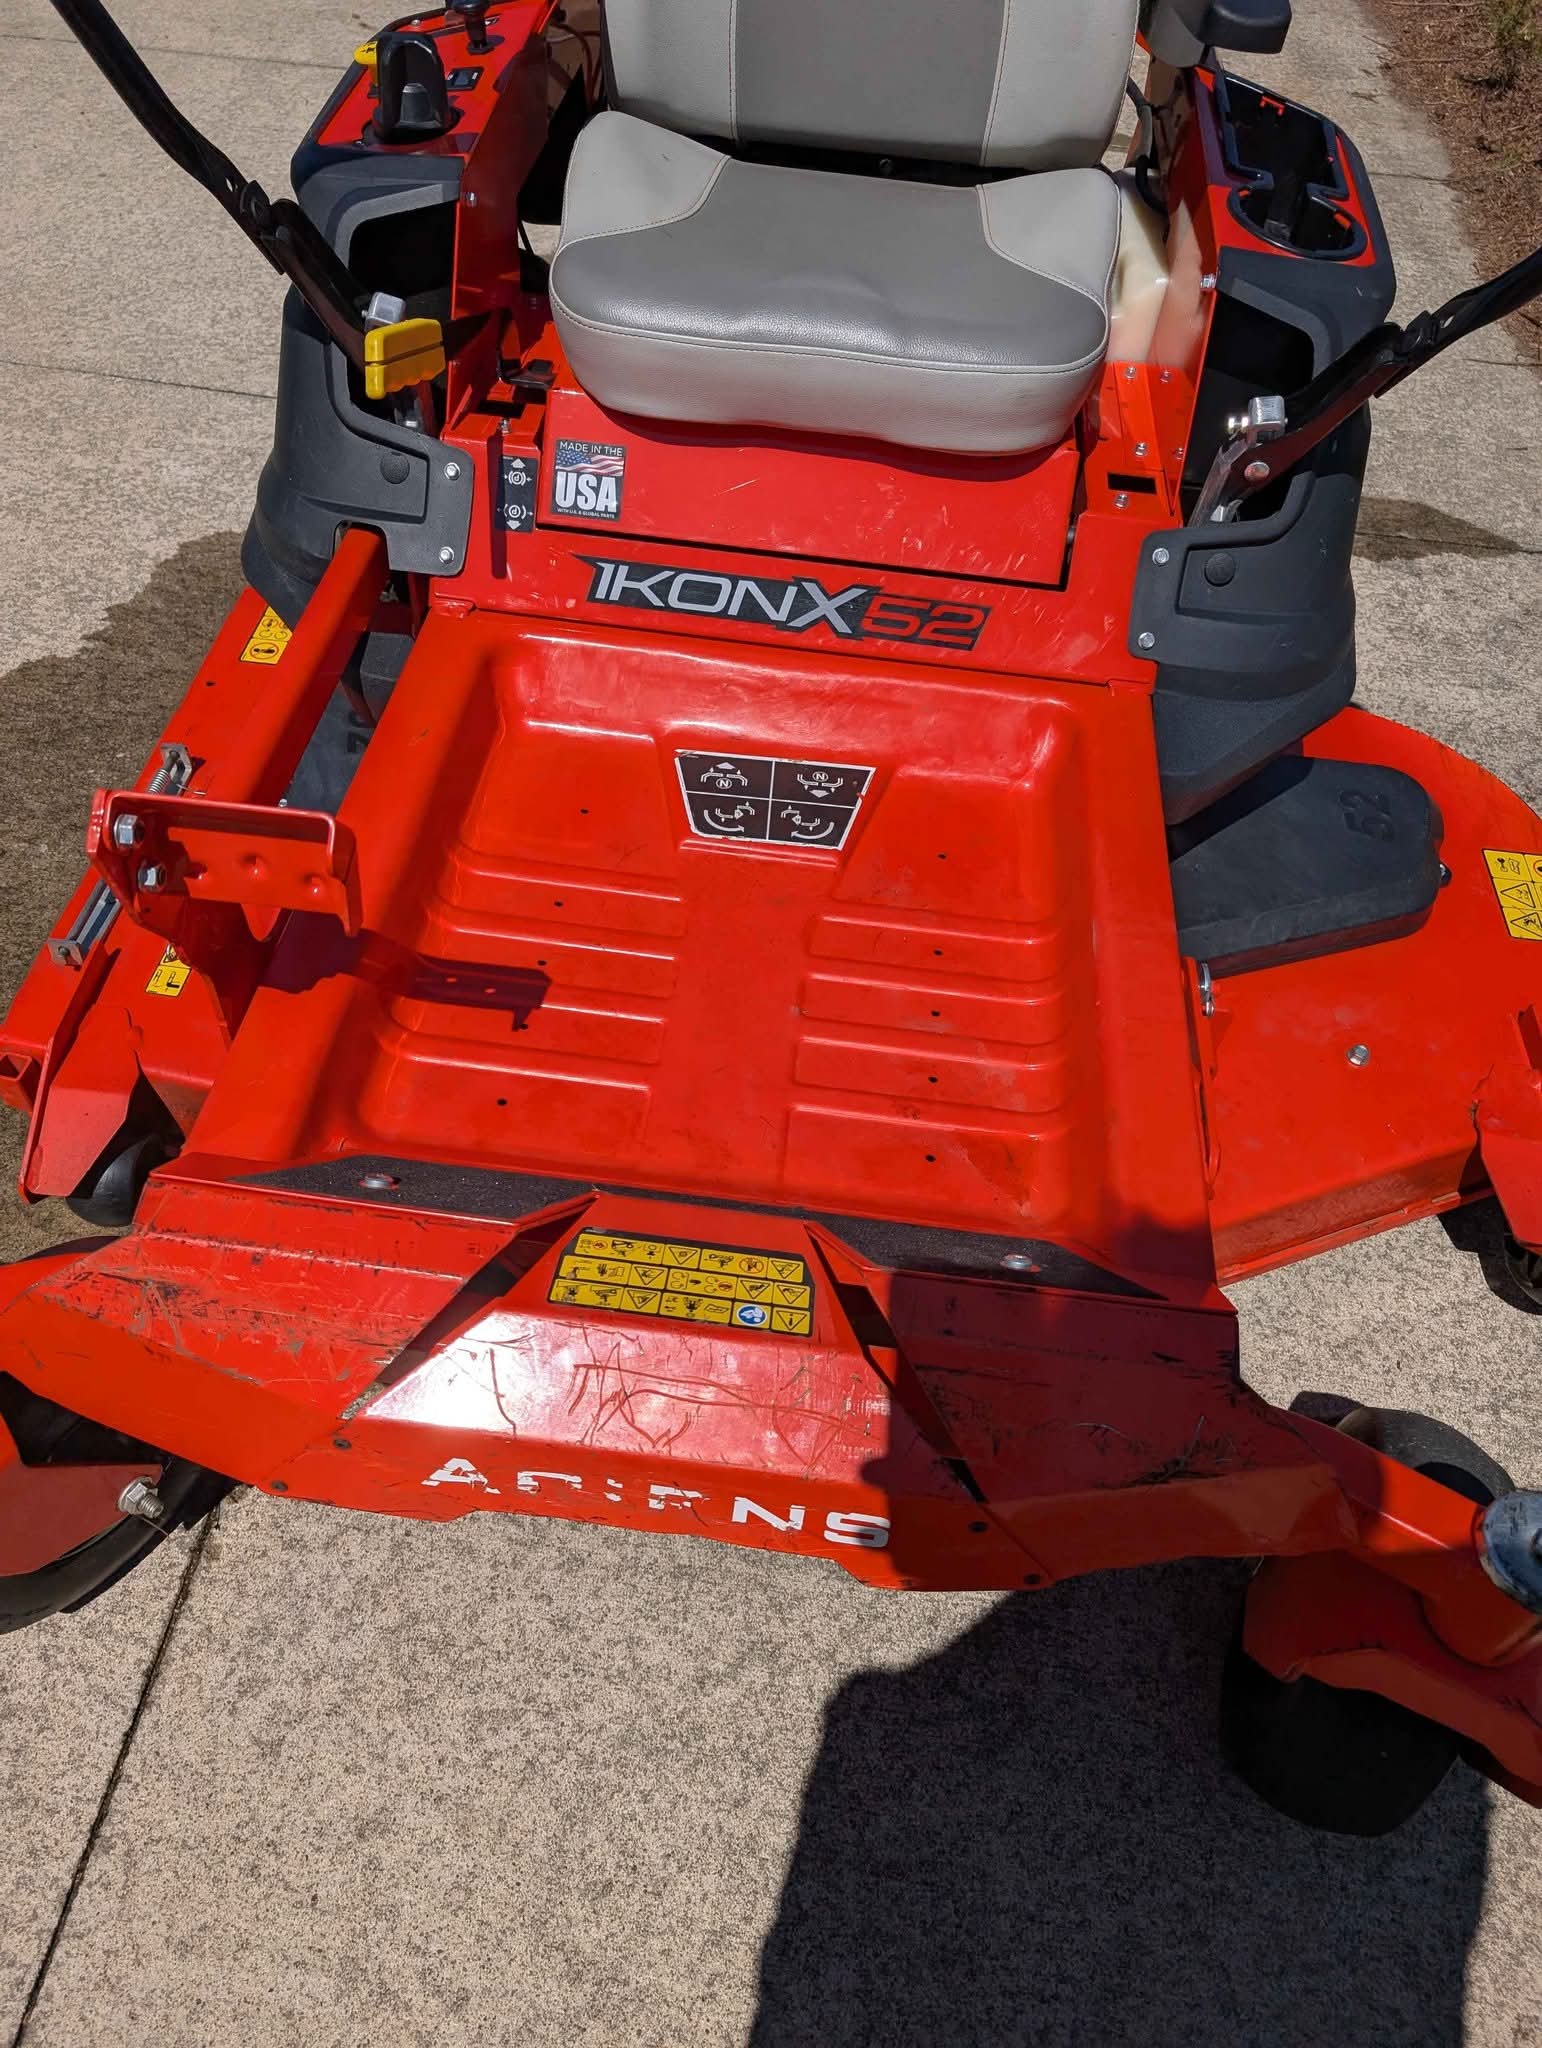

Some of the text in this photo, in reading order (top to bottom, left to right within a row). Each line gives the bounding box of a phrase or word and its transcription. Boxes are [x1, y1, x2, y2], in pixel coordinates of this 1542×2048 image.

[560, 441, 623, 456] MADE IN THE
[555, 471, 618, 513] USA
[861, 595, 985, 645] 52
